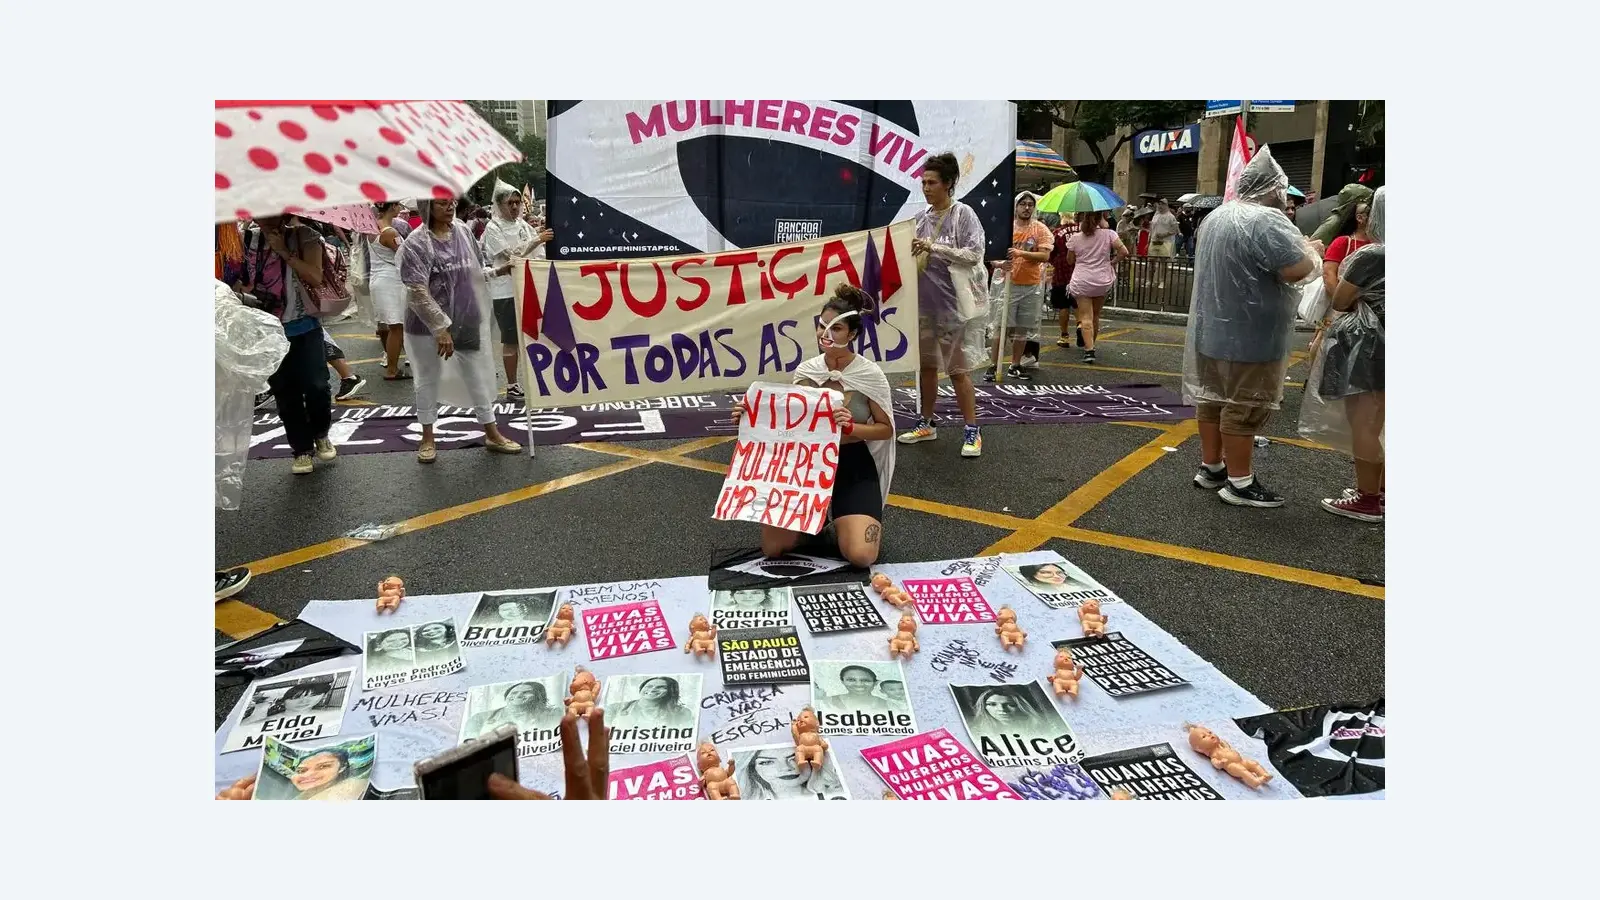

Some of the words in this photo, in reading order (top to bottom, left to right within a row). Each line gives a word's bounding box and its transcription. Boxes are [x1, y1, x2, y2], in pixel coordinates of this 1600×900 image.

[625, 100, 860, 146] MULHERES
[1139, 128, 1193, 154] CAIXA
[777, 221, 819, 233] BANCADA
[560, 245, 680, 256] @BANCADAFEMINISTAPSOL
[525, 342, 608, 397] POR
[610, 327, 747, 385] TODAS
[757, 319, 803, 376] AS
[743, 389, 837, 434] VIDA
[726, 441, 840, 490] MULHERES
[569, 585, 613, 599] NEM
[617, 581, 662, 592] UMA
[907, 582, 974, 594] VIVAS
[913, 591, 978, 599] QUEREMOS
[1038, 589, 1109, 603] Brenna
[583, 590, 656, 605] MENOS!
[797, 591, 866, 606] QUANTAS
[800, 599, 870, 612] MULHERES
[585, 606, 658, 626] VIVAS
[712, 609, 788, 619] Catarina
[805, 606, 874, 619] ACEITAMOS
[918, 602, 988, 614] VIVAS
[923, 611, 994, 622] VIVAS
[588, 615, 661, 631] QUEREMOS
[590, 621, 664, 637] MULHERES
[808, 612, 881, 629] PERDER
[590, 627, 666, 648] VIVAS
[721, 639, 750, 652] SÃO
[752, 636, 798, 649] PAULO
[592, 637, 670, 658] VIVAS
[723, 647, 778, 662] ESTADO
[781, 646, 801, 658] DE
[366, 671, 408, 683] Aliane
[412, 656, 462, 675] Pedrotti
[725, 657, 805, 673] EMERGÊNCIA
[1084, 657, 1159, 678] ACEITAMOS
[367, 678, 406, 689] Layse
[410, 662, 464, 681] Pinheiro
[726, 673, 747, 682] POR
[748, 667, 808, 680] FEMINICÍDIO
[1094, 666, 1175, 690] PERDER
[352, 691, 468, 712] MULHERES
[700, 684, 784, 710] CRIANÇA
[260, 714, 317, 733] Elda
[817, 710, 912, 727] Isabele
[608, 725, 694, 741] hristina
[817, 726, 853, 735] Gomes
[855, 726, 870, 735] de
[871, 726, 915, 735] Macedo
[639, 741, 693, 753] Oliveira
[980, 732, 1077, 757] Alice
[871, 737, 961, 774] VIVAS
[985, 755, 1043, 768] Martins
[1046, 749, 1086, 766] Alves
[888, 754, 973, 785] QUEREMOS
[1089, 757, 1187, 786] QUANTAS
[609, 765, 693, 799] IVAS
[899, 764, 984, 796] MULHERES
